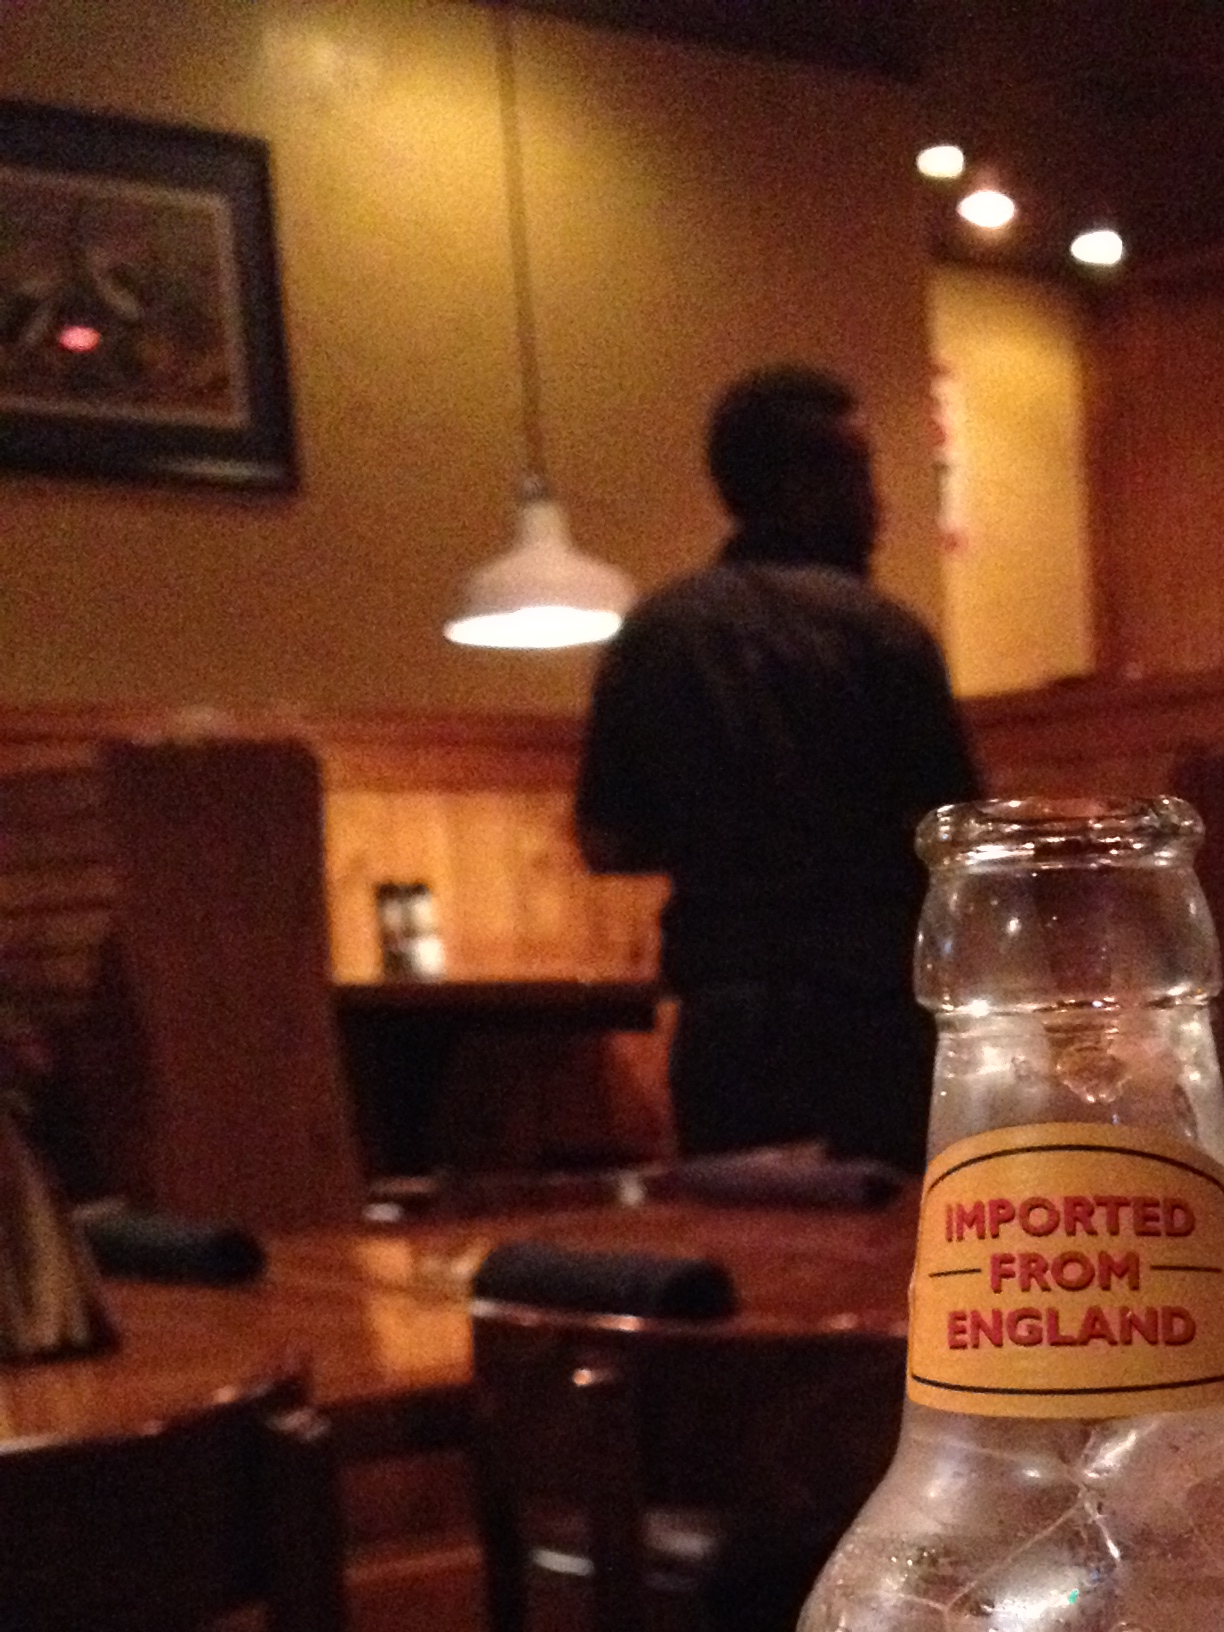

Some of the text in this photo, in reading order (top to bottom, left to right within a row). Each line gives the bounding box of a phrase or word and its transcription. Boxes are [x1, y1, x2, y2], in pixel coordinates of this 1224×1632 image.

[944, 1195, 1197, 1243] IMPORTED
[989, 1250, 1142, 1294] FROM
[946, 1305, 1197, 1350] ENGLAND
